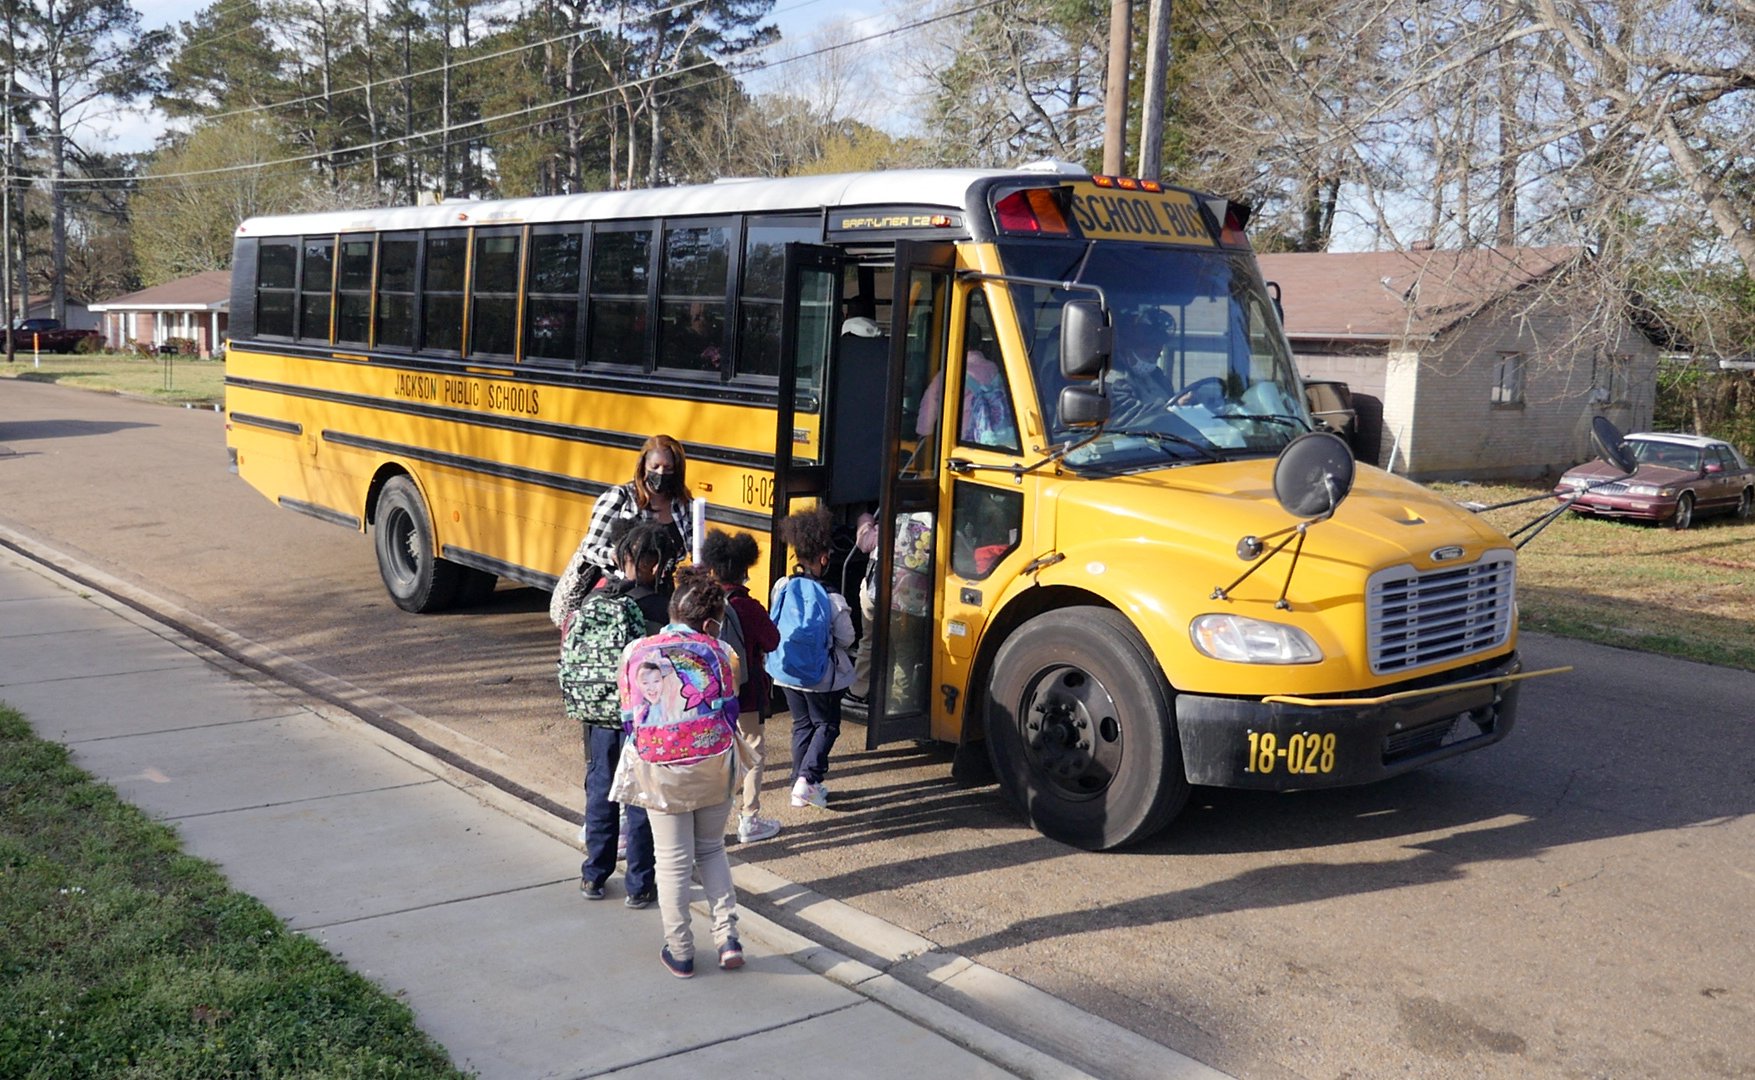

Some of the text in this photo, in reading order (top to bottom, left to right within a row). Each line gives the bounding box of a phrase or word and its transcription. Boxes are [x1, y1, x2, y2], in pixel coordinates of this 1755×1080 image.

[912, 216, 930, 226] C2
[1071, 194, 1209, 239] SCHOOL BUS
[395, 374, 539, 415] JACKSON PUBLIC SCHOOLS
[742, 474, 775, 508] 18-02
[1247, 732, 1336, 775] 18-028
